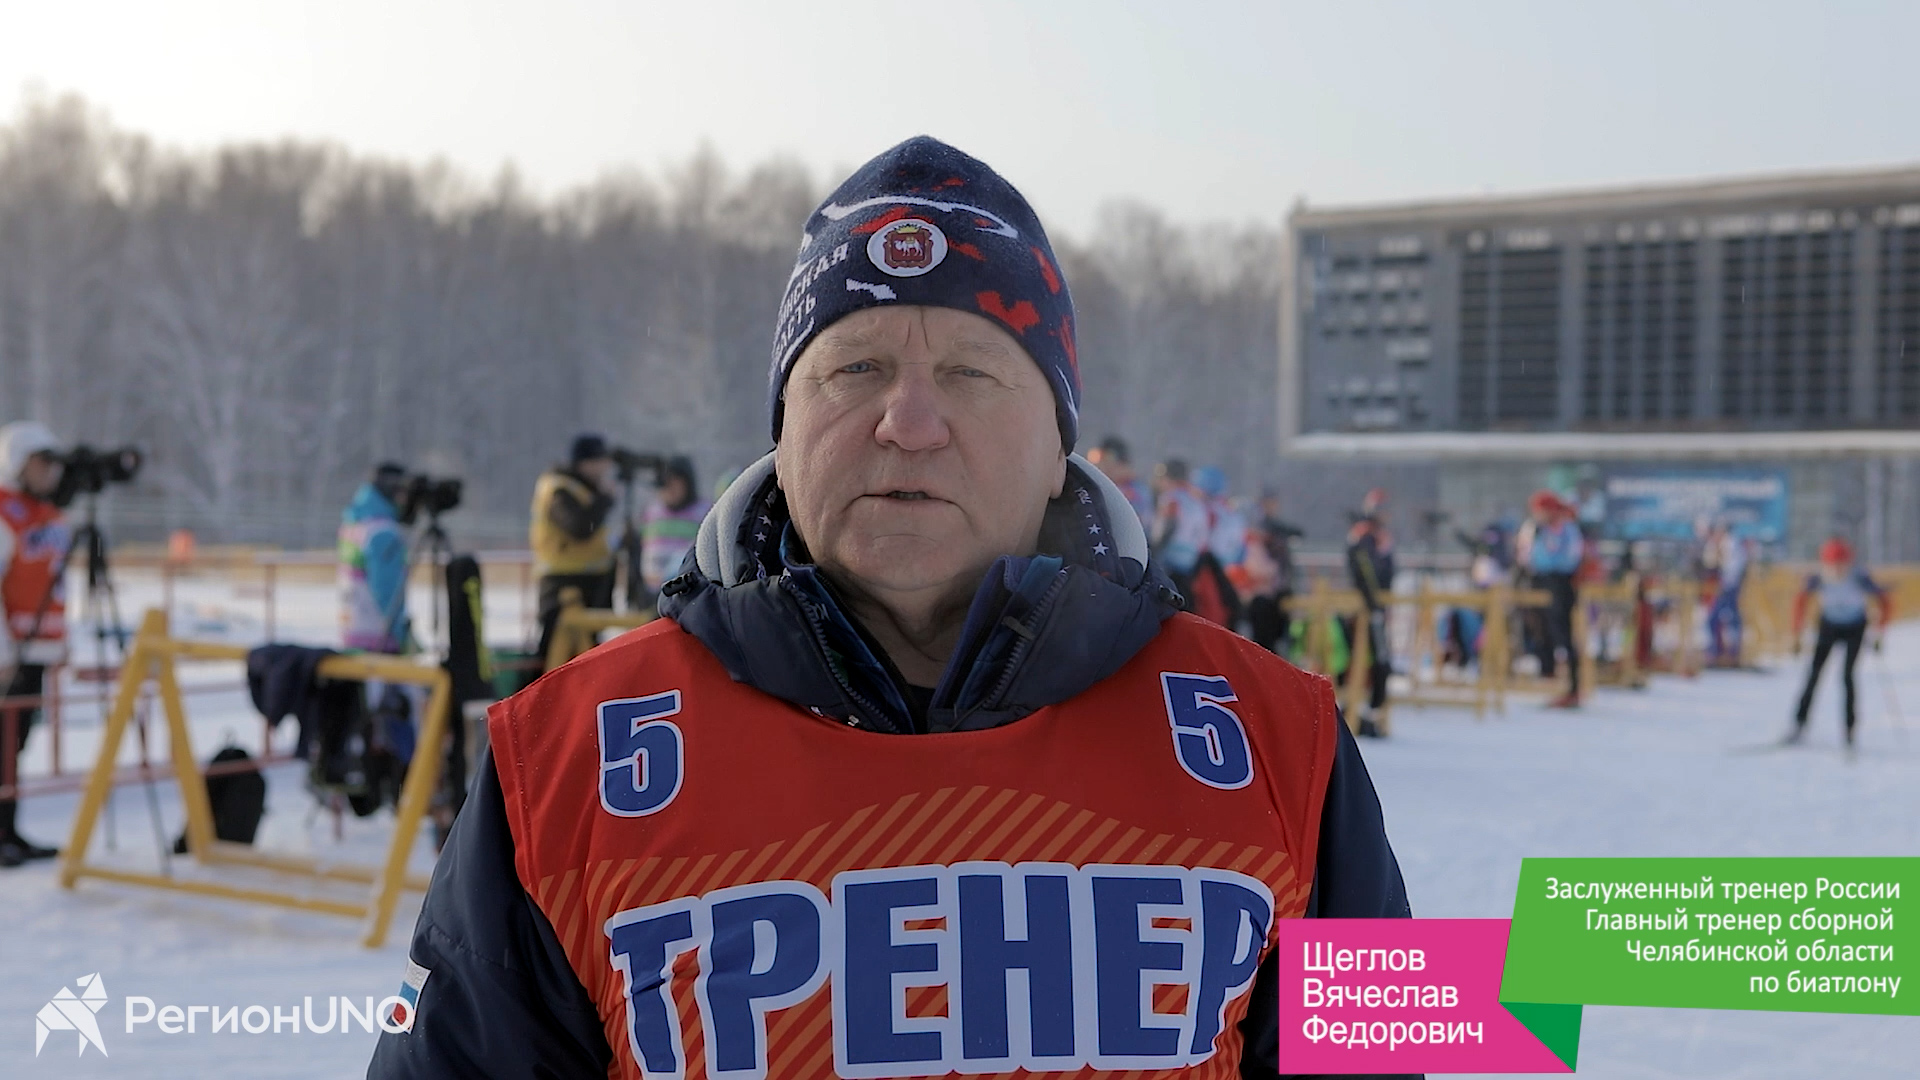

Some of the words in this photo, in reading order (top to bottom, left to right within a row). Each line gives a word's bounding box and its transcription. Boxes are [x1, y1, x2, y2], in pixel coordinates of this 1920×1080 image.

[598, 689, 684, 817] 5
[1160, 672, 1254, 789] 5
[604, 861, 1275, 1080] ТРЕНЕР
